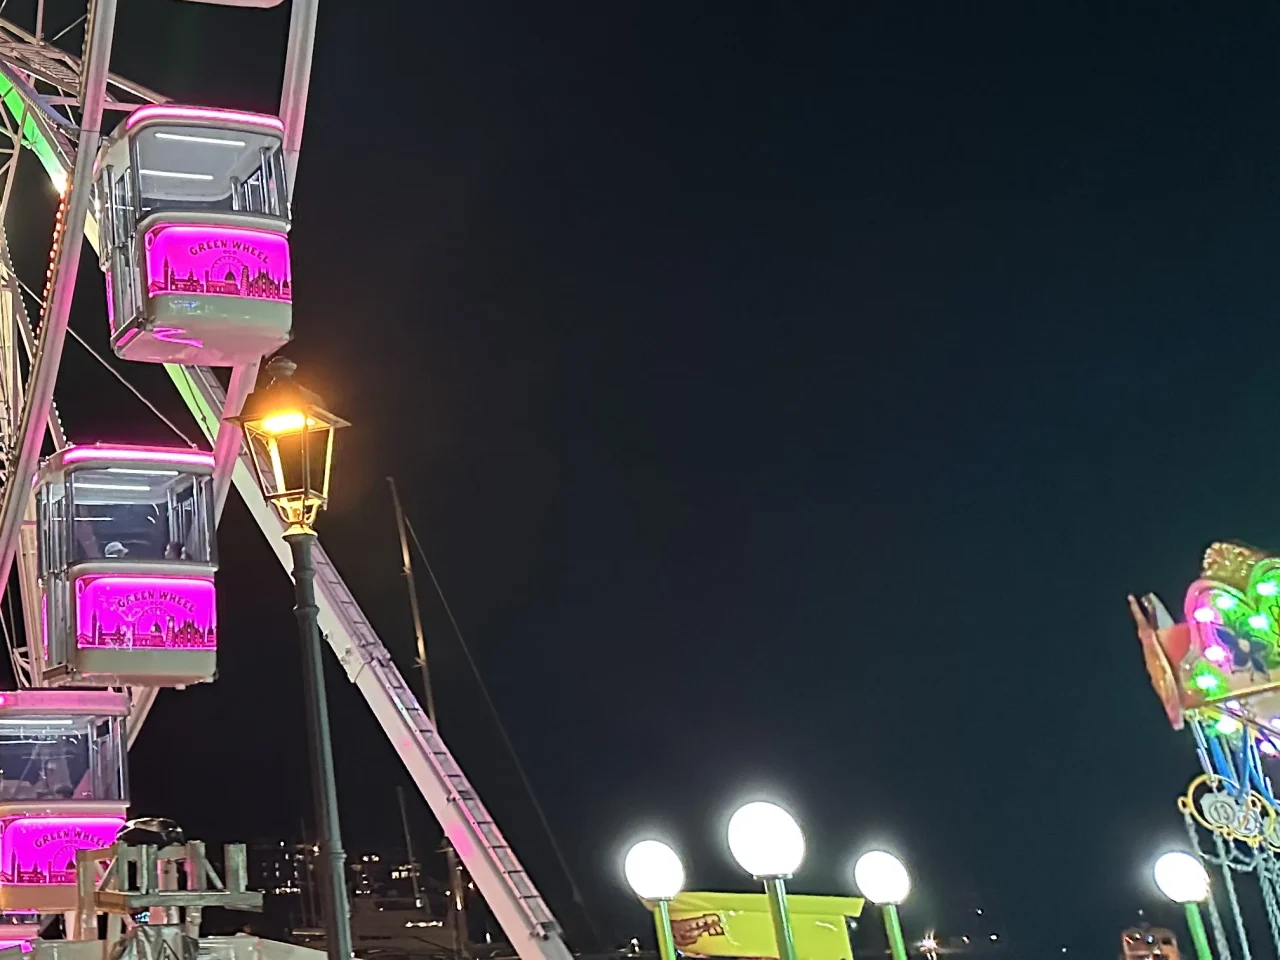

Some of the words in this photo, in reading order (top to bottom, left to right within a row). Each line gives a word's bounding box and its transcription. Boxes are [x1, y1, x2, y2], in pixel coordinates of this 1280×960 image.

[189, 239, 228, 256] GREEN
[232, 240, 269, 265] WHEEL
[117, 590, 155, 608] GREEN
[159, 591, 195, 614] WHEEL
[34, 830, 70, 848] GREEN
